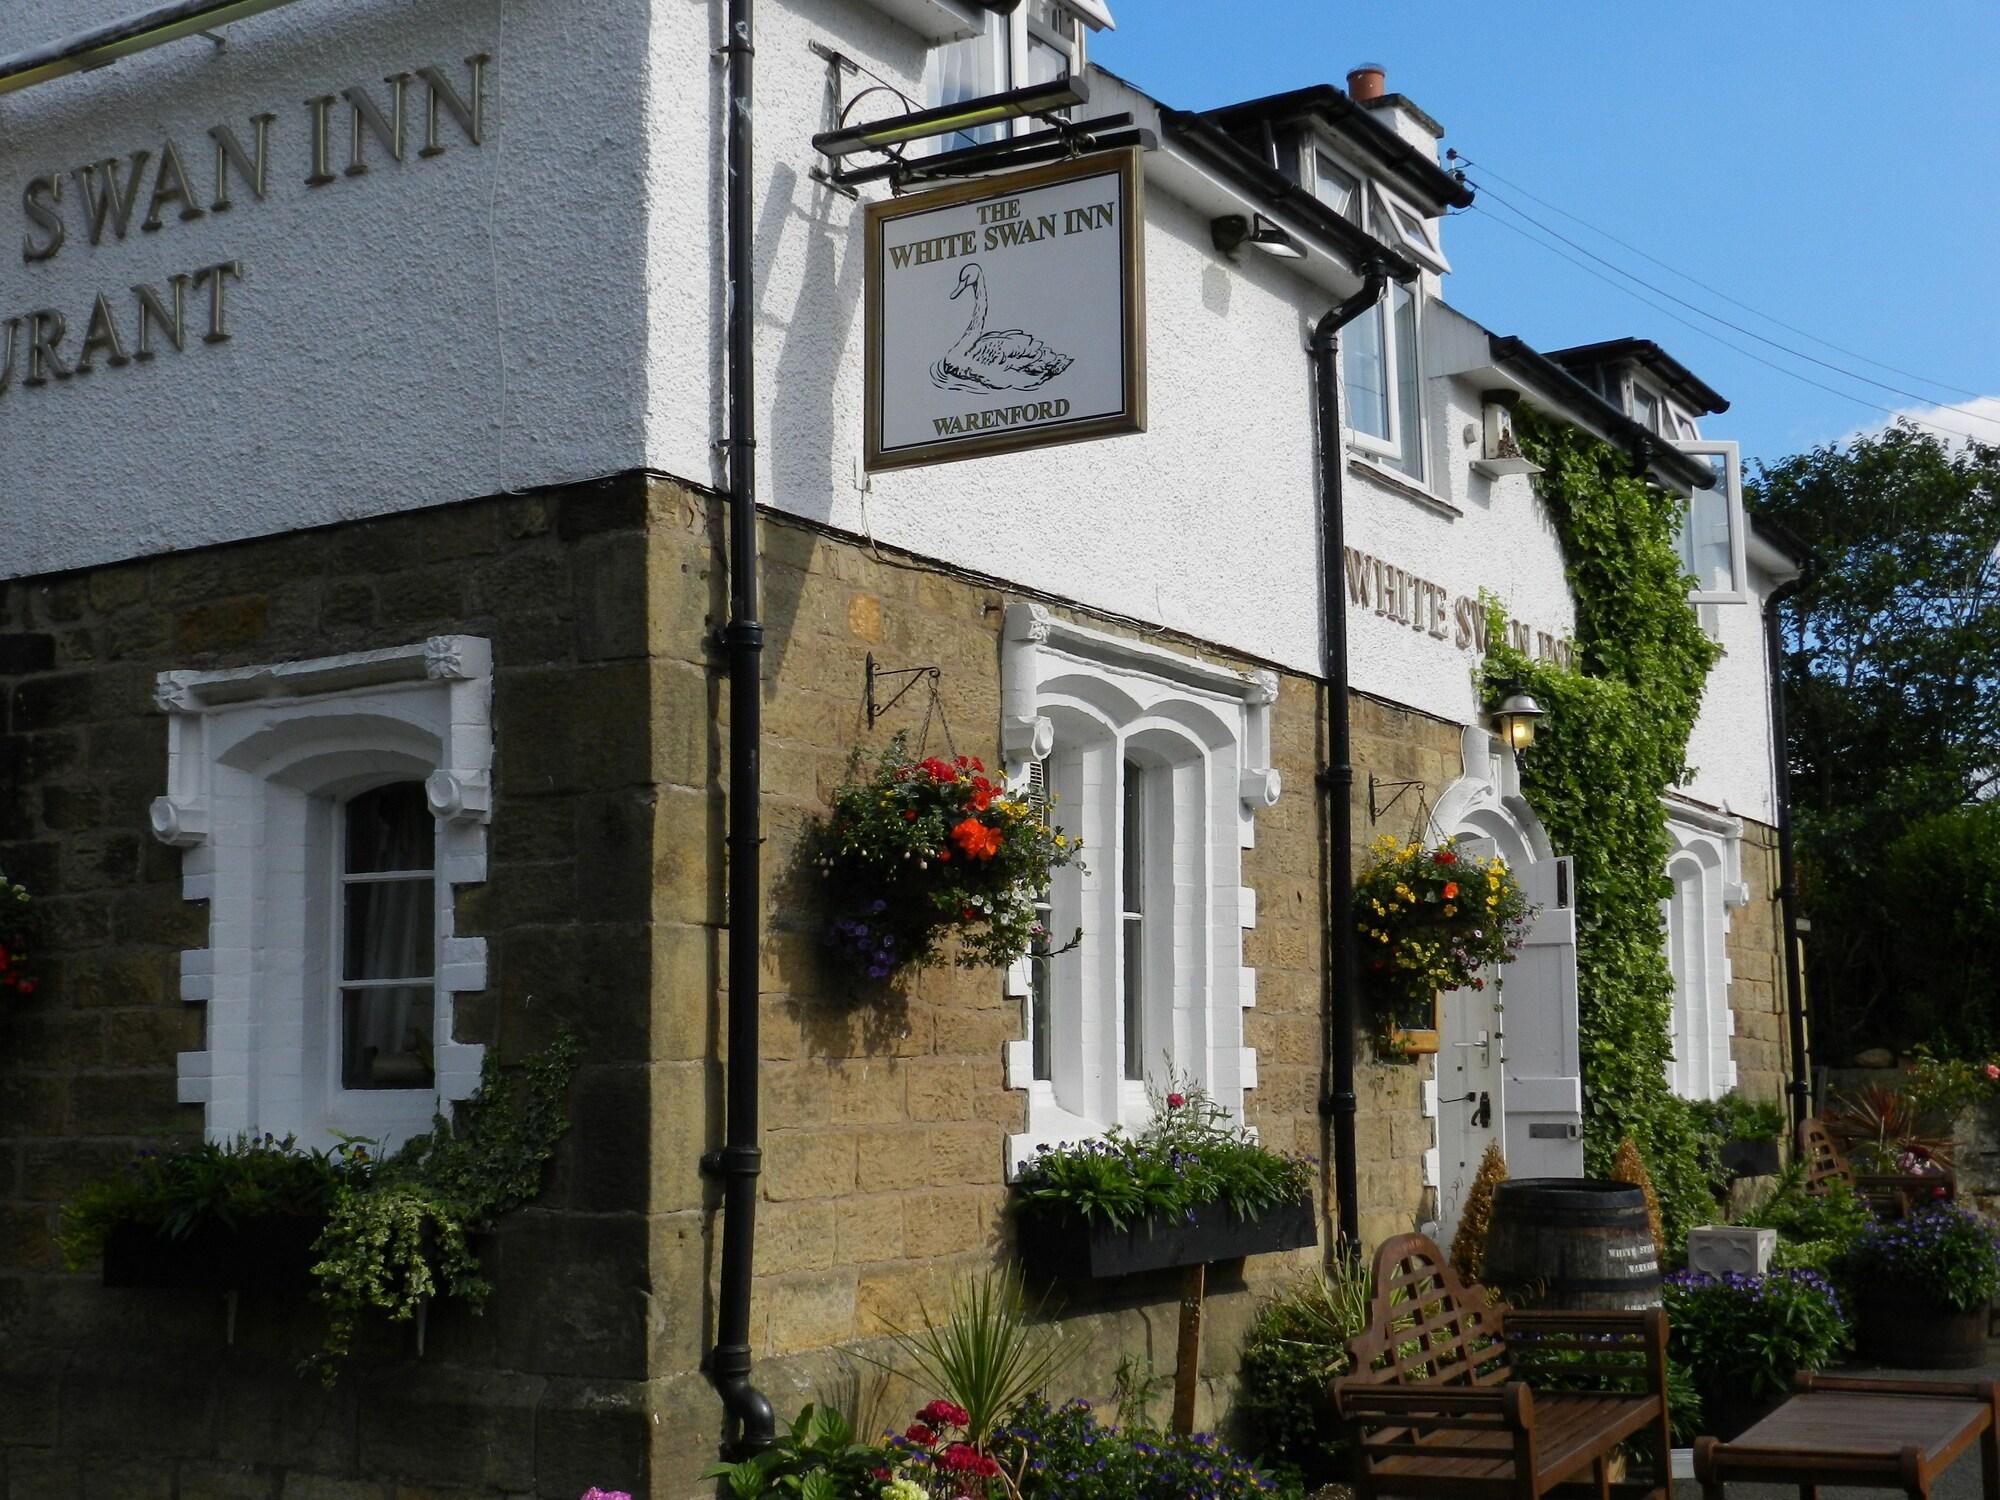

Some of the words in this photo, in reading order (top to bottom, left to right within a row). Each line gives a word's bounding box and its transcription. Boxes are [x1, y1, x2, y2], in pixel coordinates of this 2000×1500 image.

[23, 112, 276, 262] SWAN
[304, 52, 491, 186] INN
[889, 231, 977, 270] WHITE
[984, 213, 1057, 252] SWAN
[1063, 201, 1115, 236] INN
[977, 199, 1020, 225] THE
[933, 398, 1070, 437] WARENFORD
[1344, 545, 1449, 640] WHITE
[1455, 595, 1530, 660] SWN
